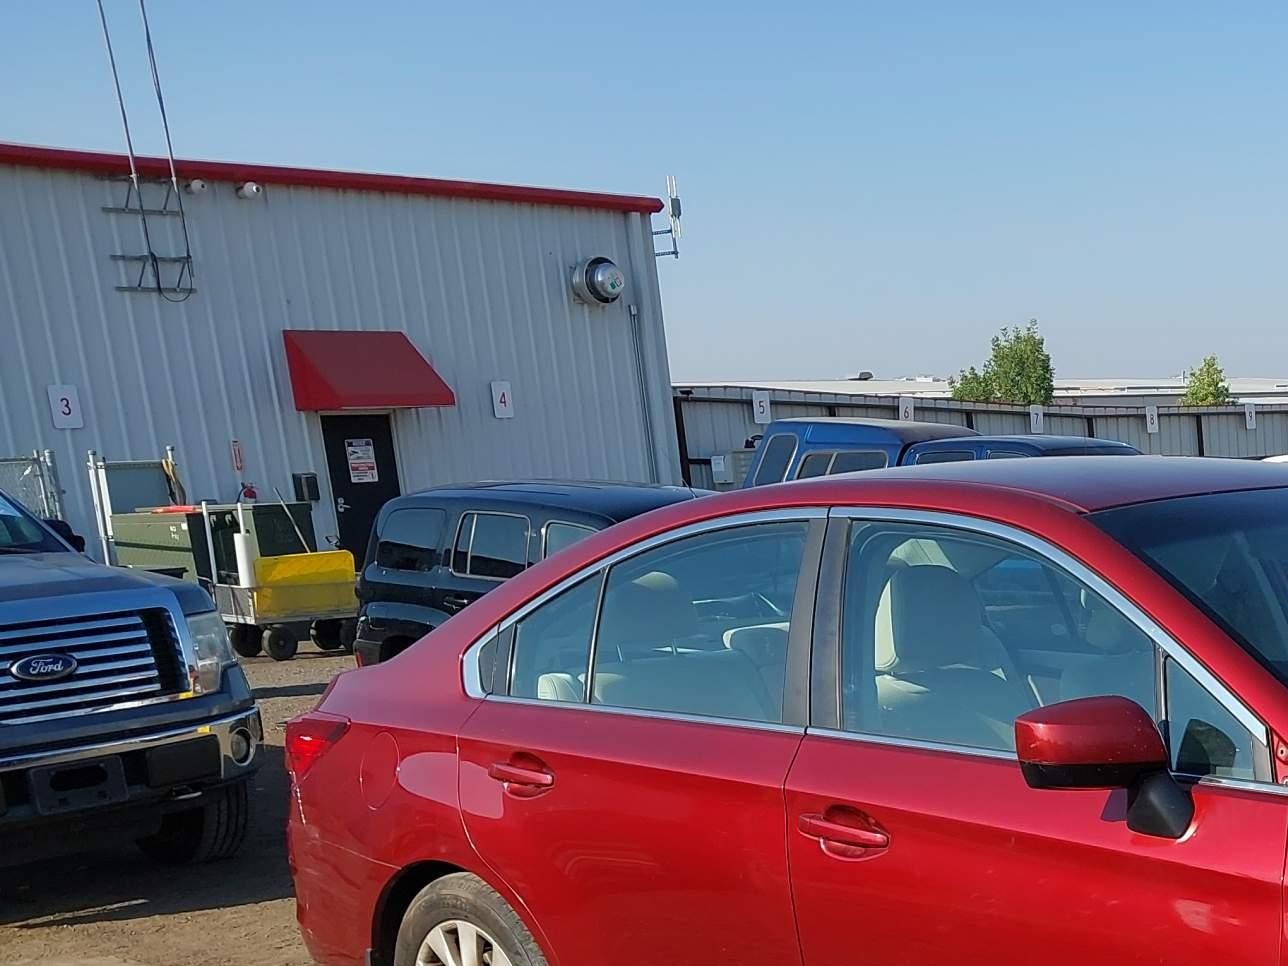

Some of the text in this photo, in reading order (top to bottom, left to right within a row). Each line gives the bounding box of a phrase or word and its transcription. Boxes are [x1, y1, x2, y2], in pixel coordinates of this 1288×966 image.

[60, 397, 72, 416] 3
[499, 391, 507, 408] 4
[758, 400, 766, 415] 5
[903, 406, 910, 419] 6
[1033, 412, 1040, 425] 7
[1149, 415, 1155, 425] 8
[1248, 411, 1253, 422] 9
[29, 658, 64, 675] Ford
